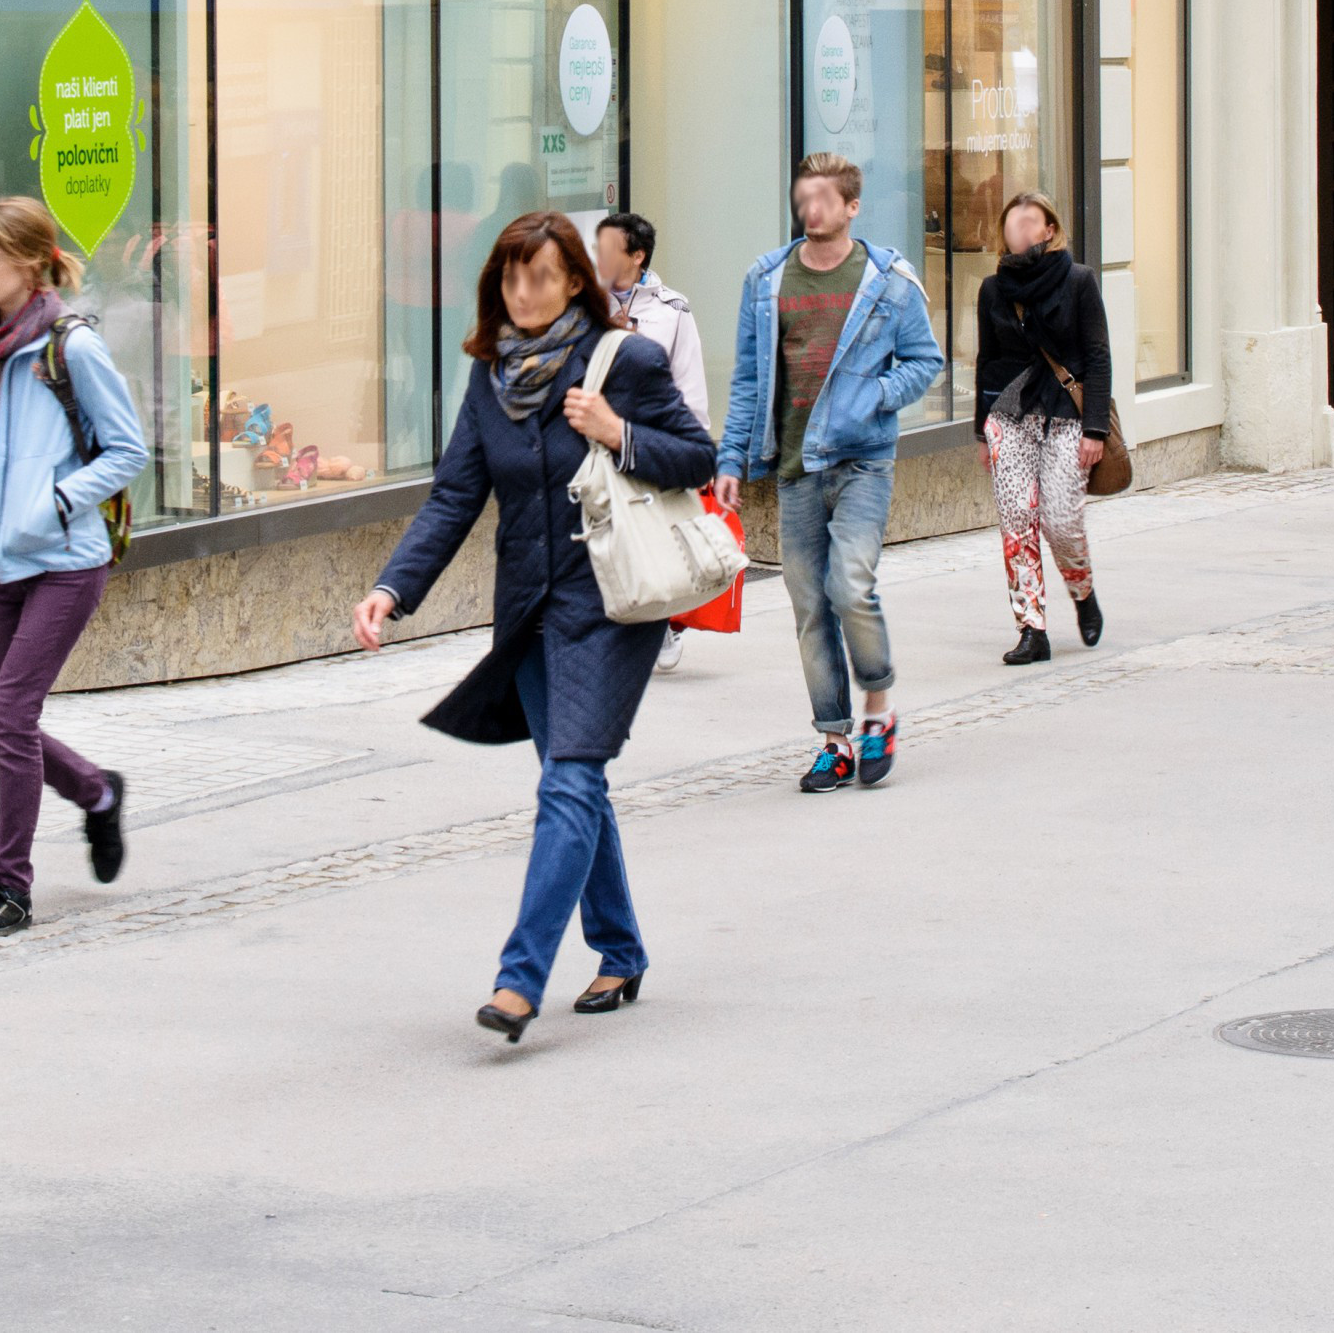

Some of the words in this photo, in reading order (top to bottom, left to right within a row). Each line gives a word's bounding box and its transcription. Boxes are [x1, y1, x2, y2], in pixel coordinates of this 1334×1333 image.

[569, 37, 597, 50] Garance
[821, 45, 844, 58] Garance
[55, 77, 81, 98] naši
[83, 75, 119, 97] klienti
[569, 85, 593, 106] ceny
[821, 89, 841, 107] ceny
[91, 107, 112, 133] jen
[542, 134, 566, 154] XXS
[967, 131, 1008, 157] milujeme
[57, 141, 119, 173] poloviční
[65, 174, 112, 199] doplatky
